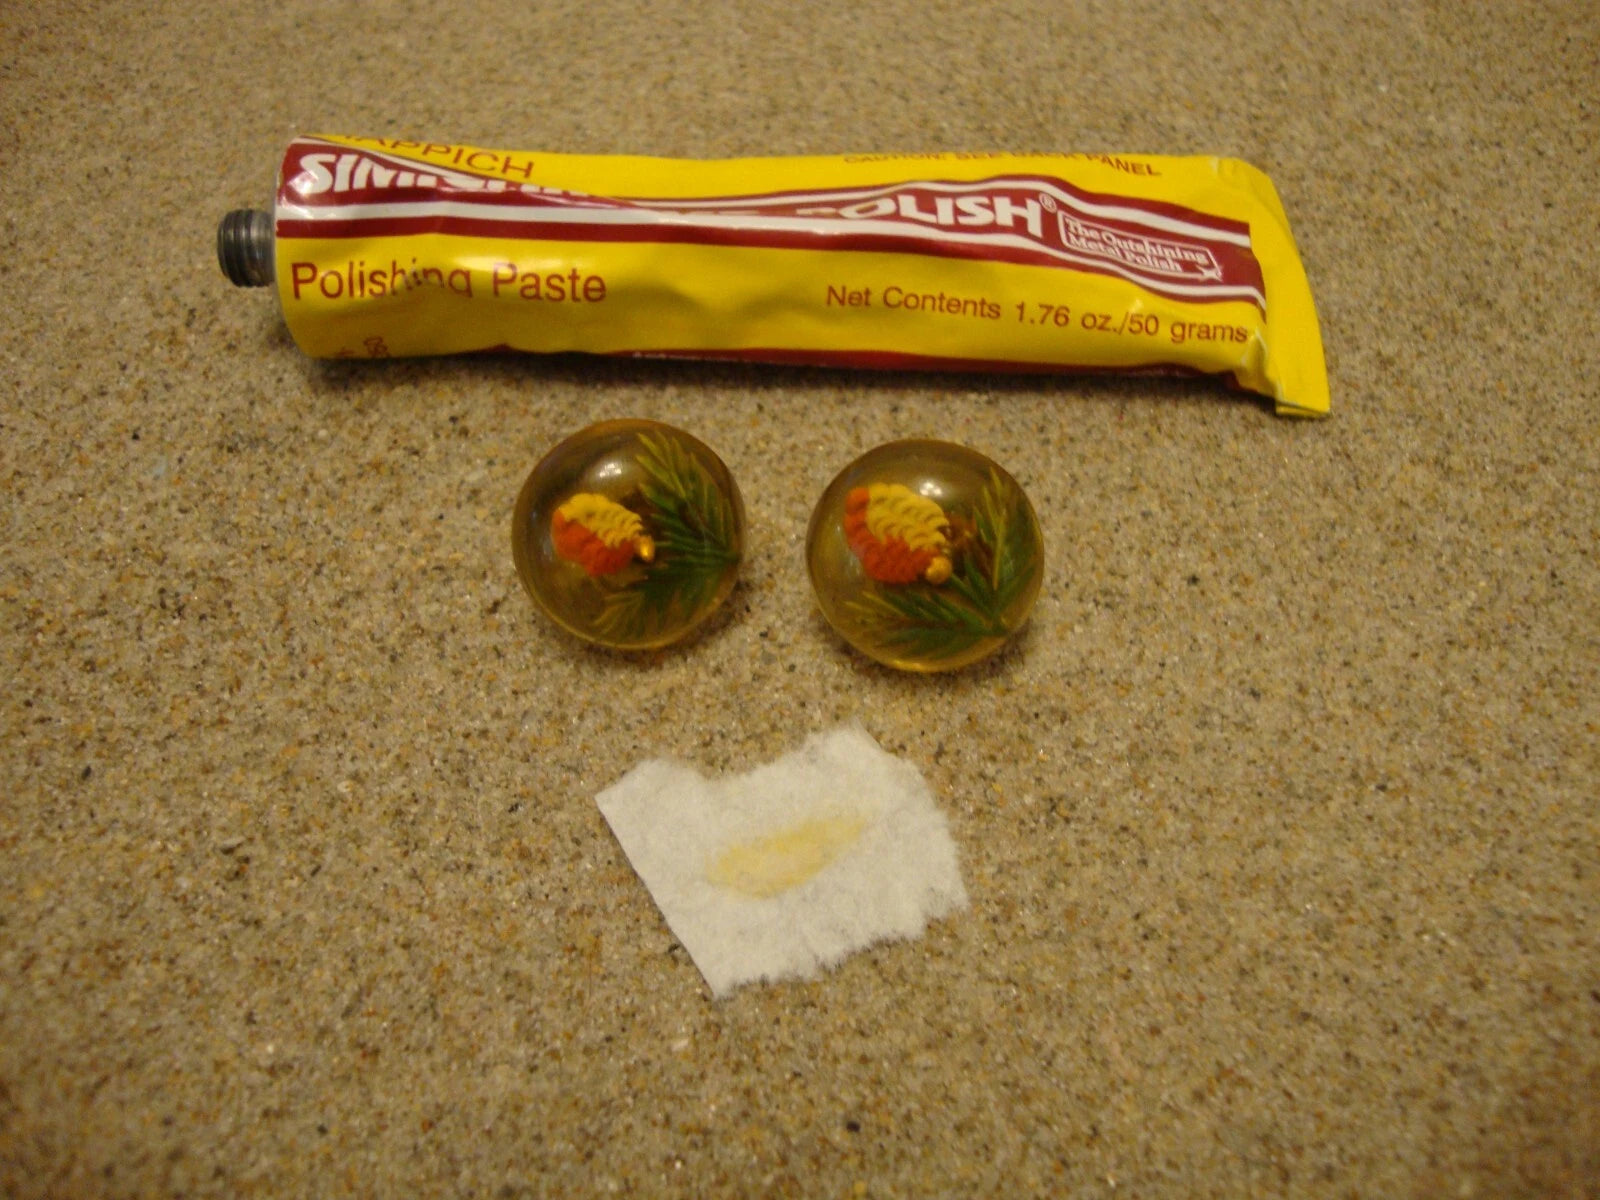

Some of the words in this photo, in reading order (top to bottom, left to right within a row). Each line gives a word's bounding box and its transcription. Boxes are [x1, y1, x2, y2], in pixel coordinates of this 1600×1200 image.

[1064, 216, 1100, 239] The
[1066, 232, 1122, 260] Metal
[1123, 250, 1184, 273] Polish
[492, 260, 608, 303] Paste
[825, 284, 872, 308] Net
[882, 285, 1002, 320] Contents
[1014, 301, 1070, 328] 1.76
[1080, 311, 1161, 337] oz./50
[1169, 319, 1250, 345] grams
